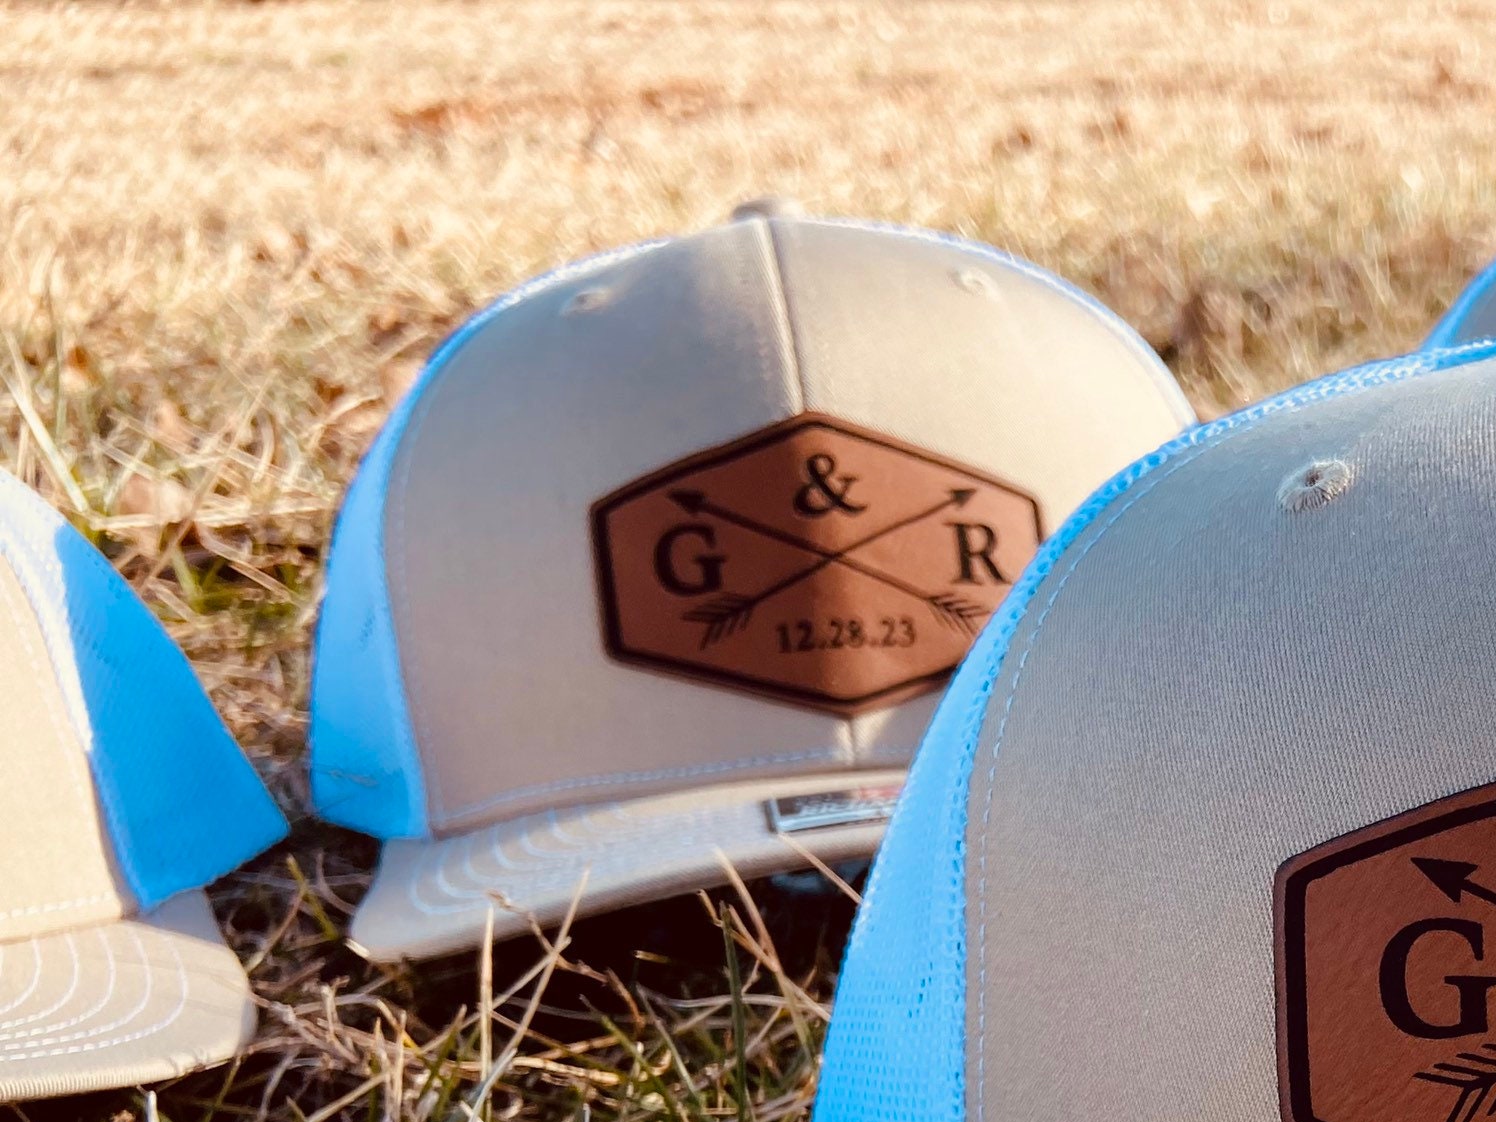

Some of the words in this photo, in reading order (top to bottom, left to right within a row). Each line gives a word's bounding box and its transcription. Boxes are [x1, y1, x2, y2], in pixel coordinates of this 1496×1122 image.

[794, 454, 867, 516] &
[654, 524, 726, 594] G
[945, 522, 1014, 586] R
[778, 619, 916, 653] 12.28.23
